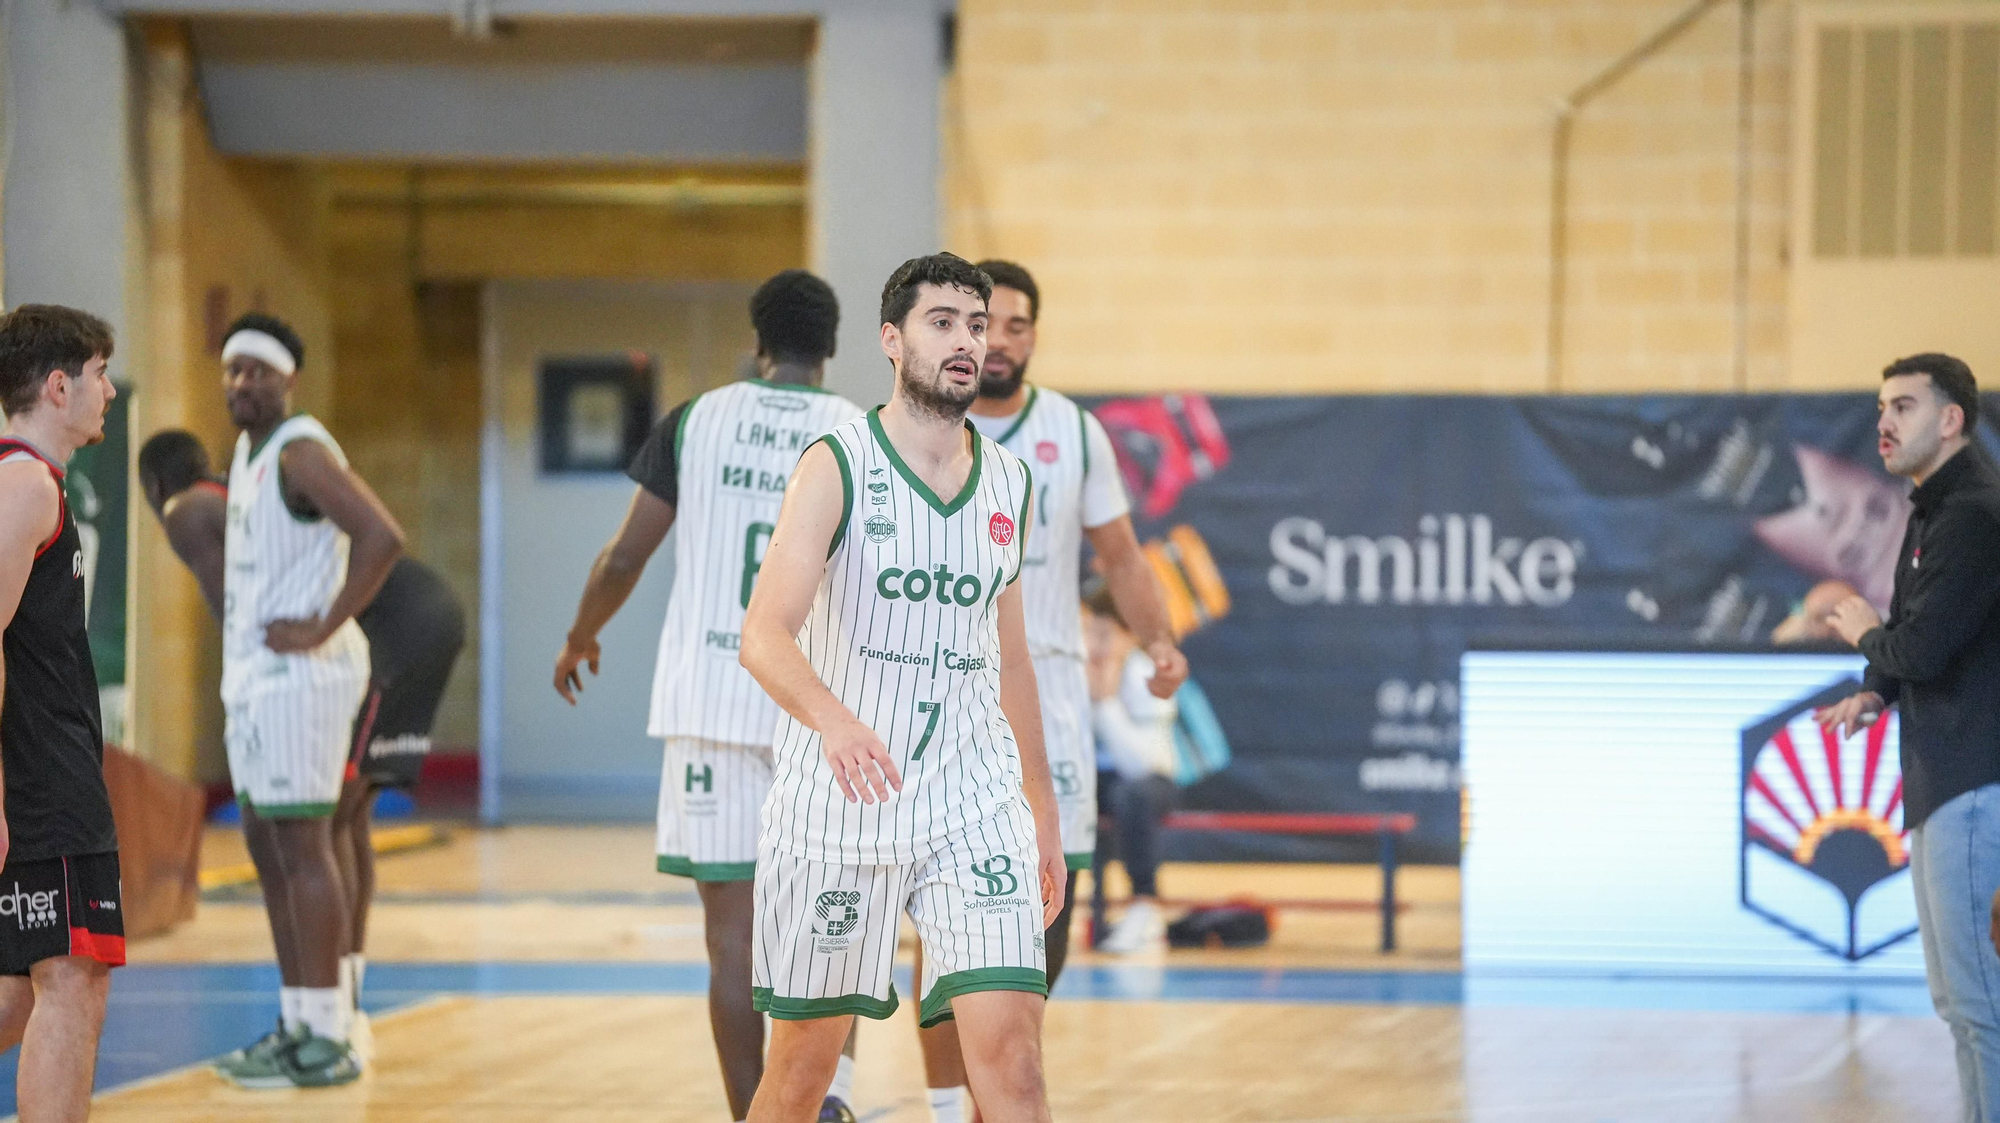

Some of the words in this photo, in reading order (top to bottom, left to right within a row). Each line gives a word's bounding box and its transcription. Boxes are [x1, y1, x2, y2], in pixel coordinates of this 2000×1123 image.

[1267, 512, 1577, 607] Smilke
[876, 564, 982, 608] coto
[859, 646, 930, 667] Fundación
[911, 701, 941, 761] 7
[963, 896, 1030, 911] SohoBoutique
[986, 907, 1012, 915] HOTELS
